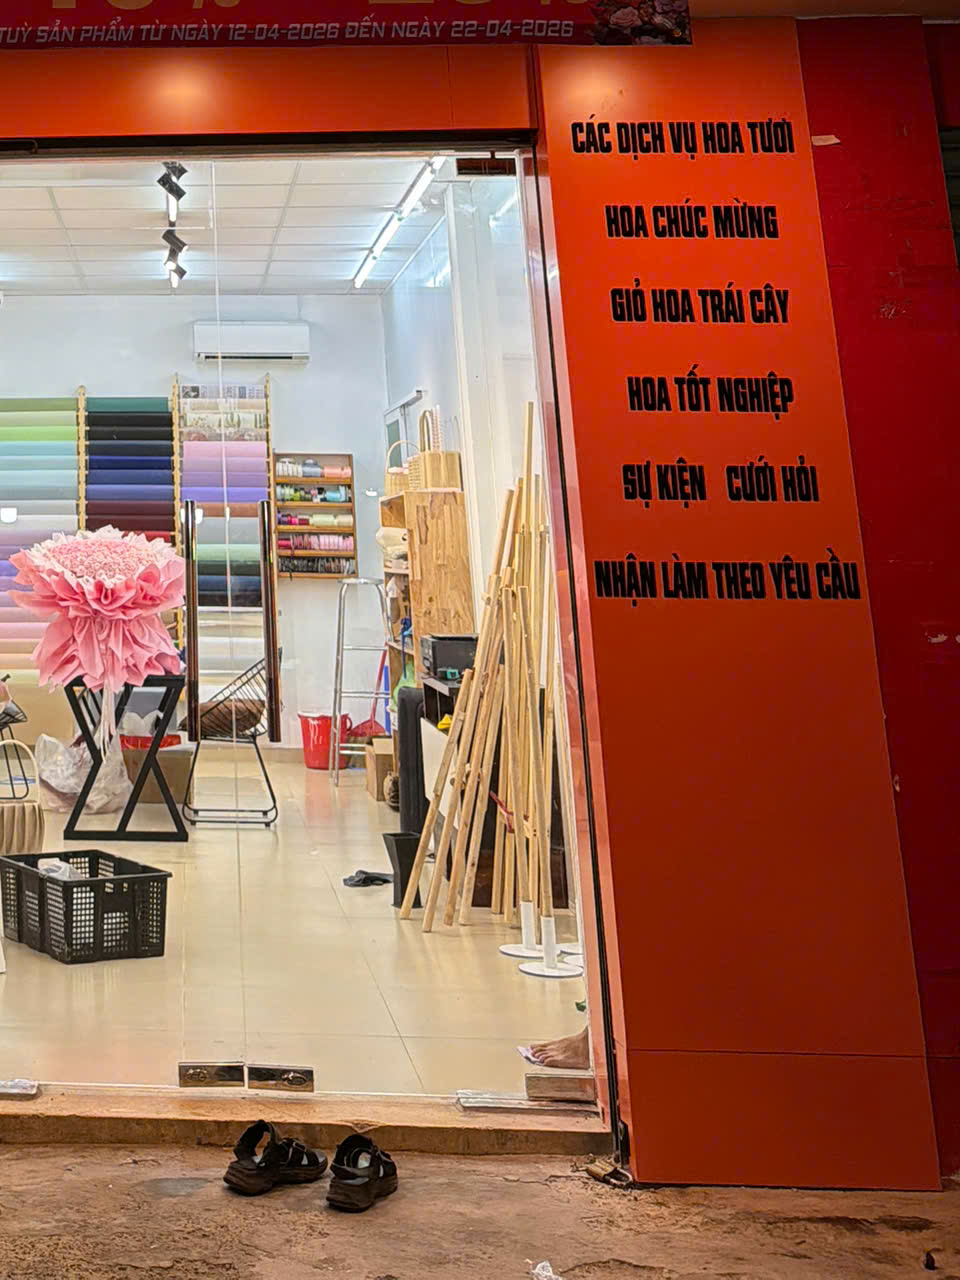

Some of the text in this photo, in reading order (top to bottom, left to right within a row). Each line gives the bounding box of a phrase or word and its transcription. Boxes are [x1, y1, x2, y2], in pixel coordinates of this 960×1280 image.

[36, 19, 75, 43] SẢN
[80, 16, 135, 42] PHẨM
[140, 21, 166, 41] TỪ
[171, 19, 222, 41] NGÀY
[228, 22, 340, 41] 12-04-2026
[345, 13, 386, 39] ĐẾN
[391, 16, 445, 38] NGÀY
[451, 19, 574, 37] 22-04-2026
[571, 114, 795, 160] CÁC DỊCH VỤ HOA TƯƠI
[605, 197, 779, 238] HOA CHÚC MỪNG
[610, 278, 789, 323] GIỎ HOA TRÁI CÂY
[627, 364, 794, 420] HOA TỐT NGHIỆP
[622, 455, 819, 508] SỰ KIỆN CƯỚI HỎI
[593, 547, 862, 607] NHẬN LÀM THEO YÊU CẦU
